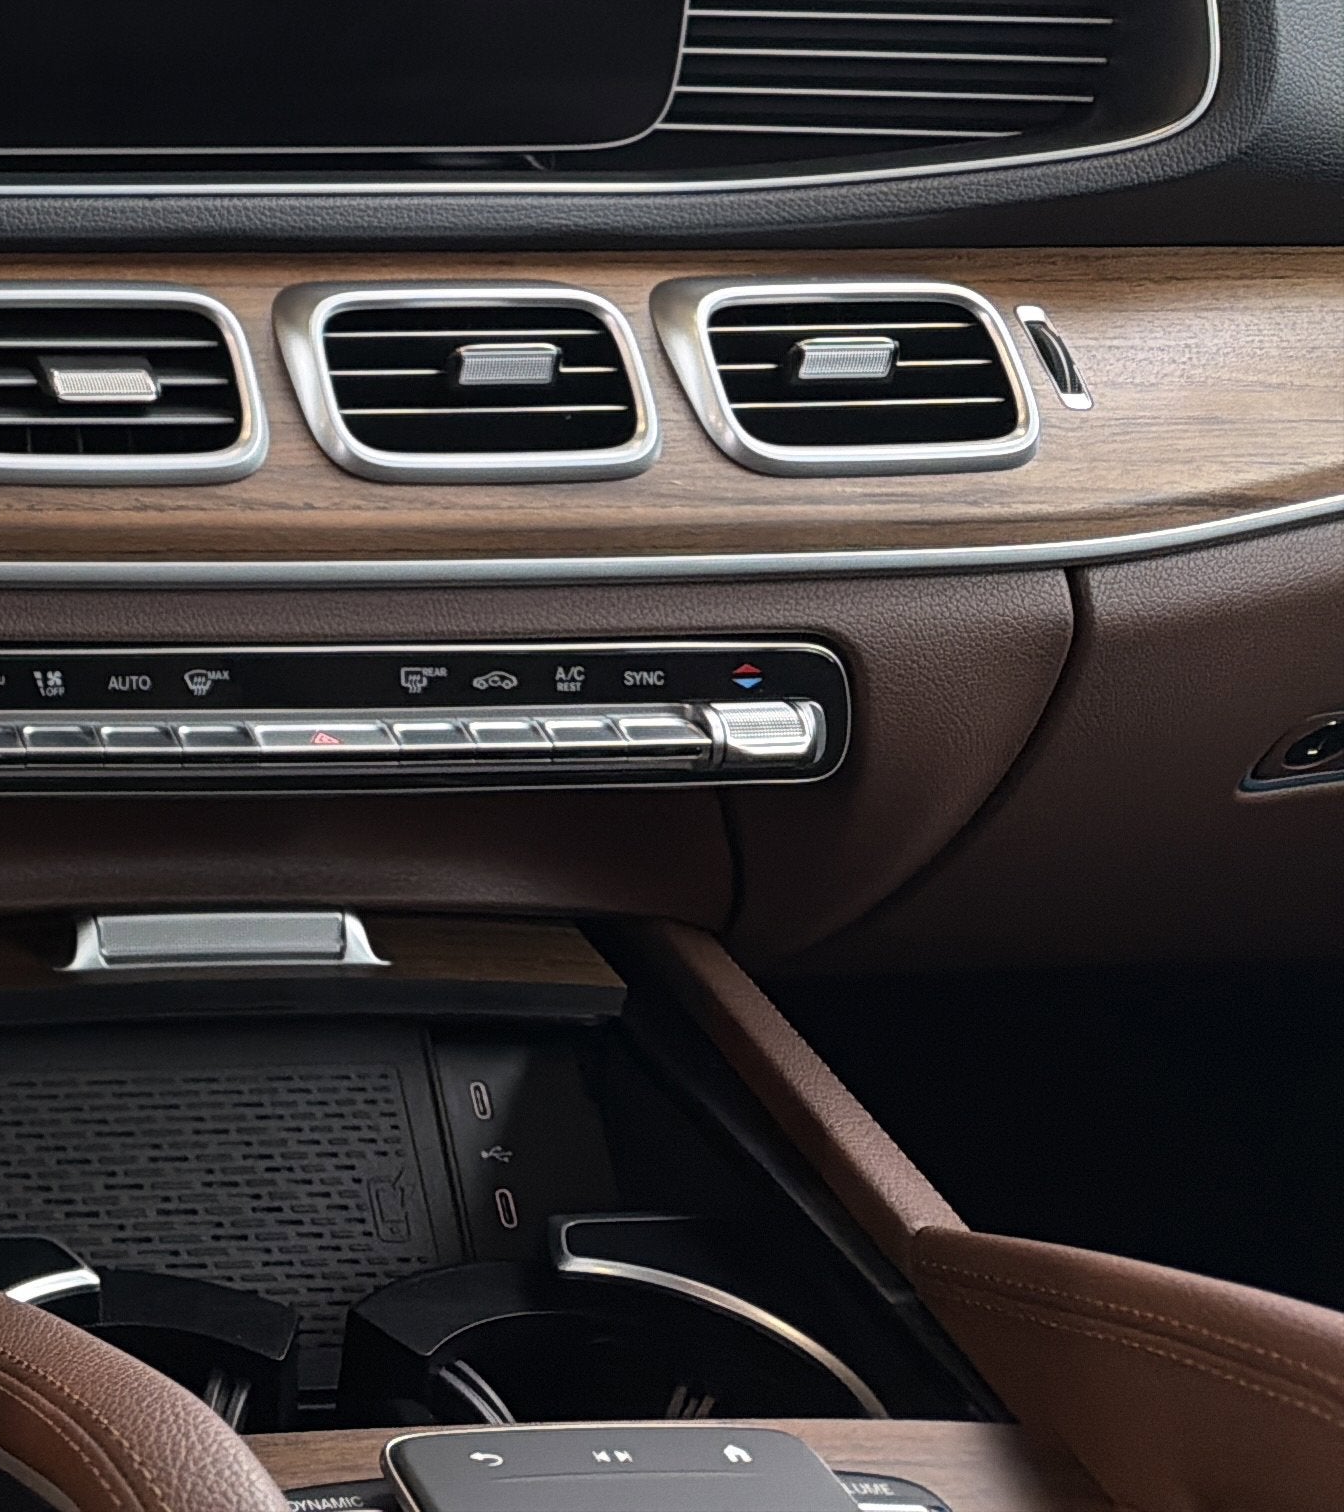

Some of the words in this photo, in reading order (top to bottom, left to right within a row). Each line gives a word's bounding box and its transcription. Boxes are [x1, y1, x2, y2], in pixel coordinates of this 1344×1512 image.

[207, 670, 230, 681] MAX
[422, 667, 448, 677] REAR
[555, 666, 586, 681] A/C
[108, 675, 152, 691] AUTO
[623, 670, 665, 686] SYNC
[45, 687, 66, 697] OFF
[556, 682, 583, 692] REST
